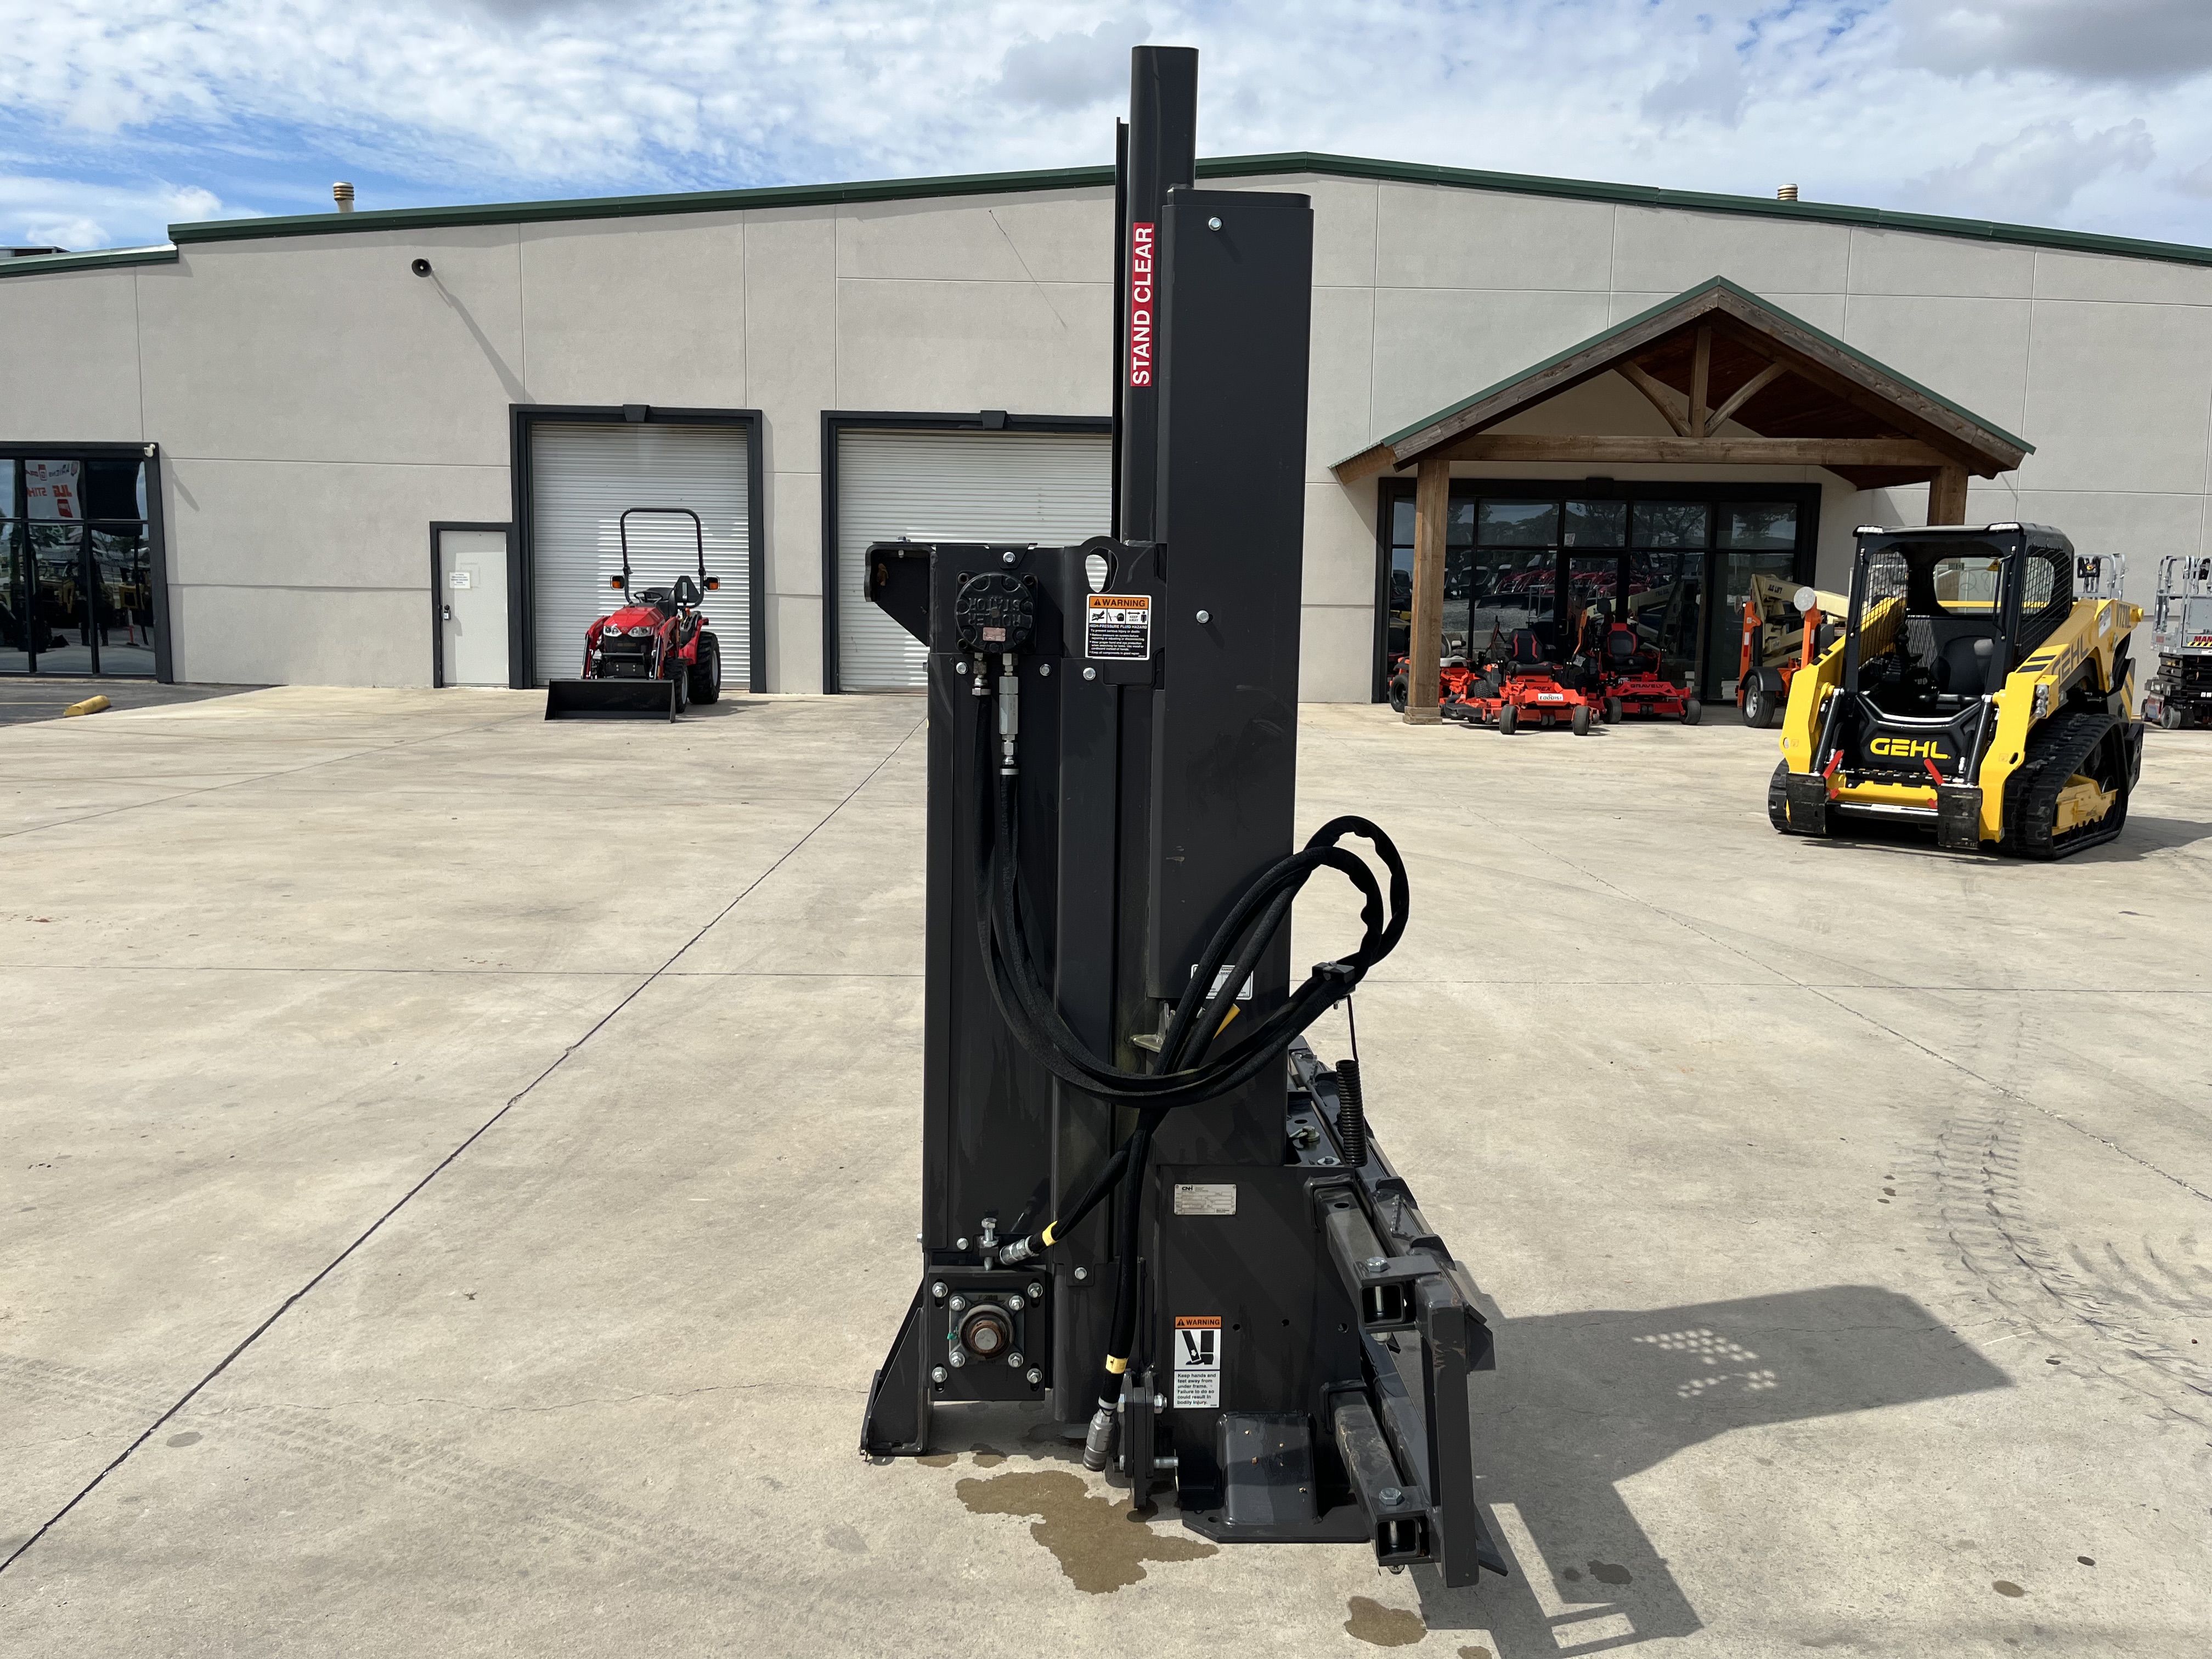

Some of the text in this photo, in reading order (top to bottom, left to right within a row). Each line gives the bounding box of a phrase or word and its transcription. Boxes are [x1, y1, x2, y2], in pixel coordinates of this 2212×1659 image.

[1132, 228, 1152, 385] STAND CLEAR
[1102, 599, 1146, 607] WARNING
[2051, 633, 2089, 684] GEHL
[1870, 737, 1948, 759] GEHL
